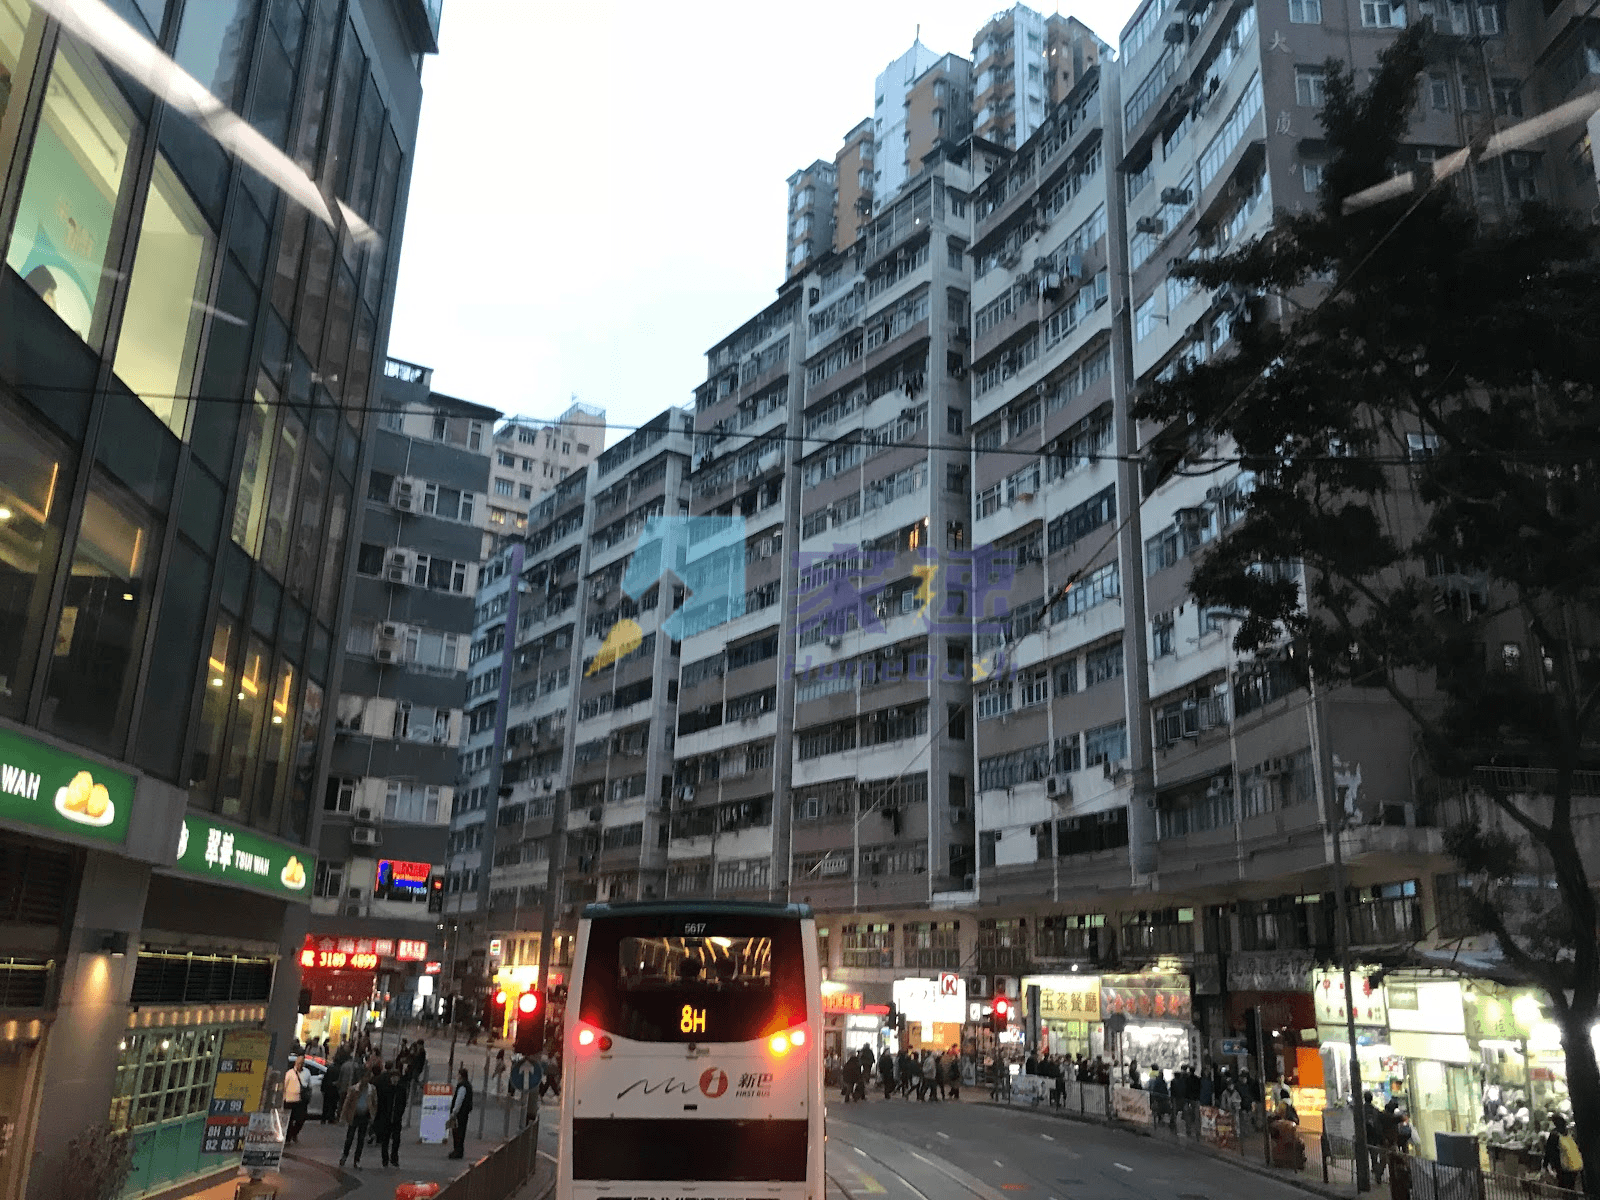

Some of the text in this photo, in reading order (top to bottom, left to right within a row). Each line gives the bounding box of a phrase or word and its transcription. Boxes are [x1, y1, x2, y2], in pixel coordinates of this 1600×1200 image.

[2, 763, 41, 801] WAH
[205, 827, 271, 877] 翠華 TSUI WAH
[680, 1004, 706, 1033] 8H
[738, 1072, 774, 1089] 新巴
[735, 1090, 755, 1098] FIRST
[214, 1100, 242, 1112] 77 99
[225, 1126, 236, 1137] 81
[206, 1139, 218, 1151] 82
